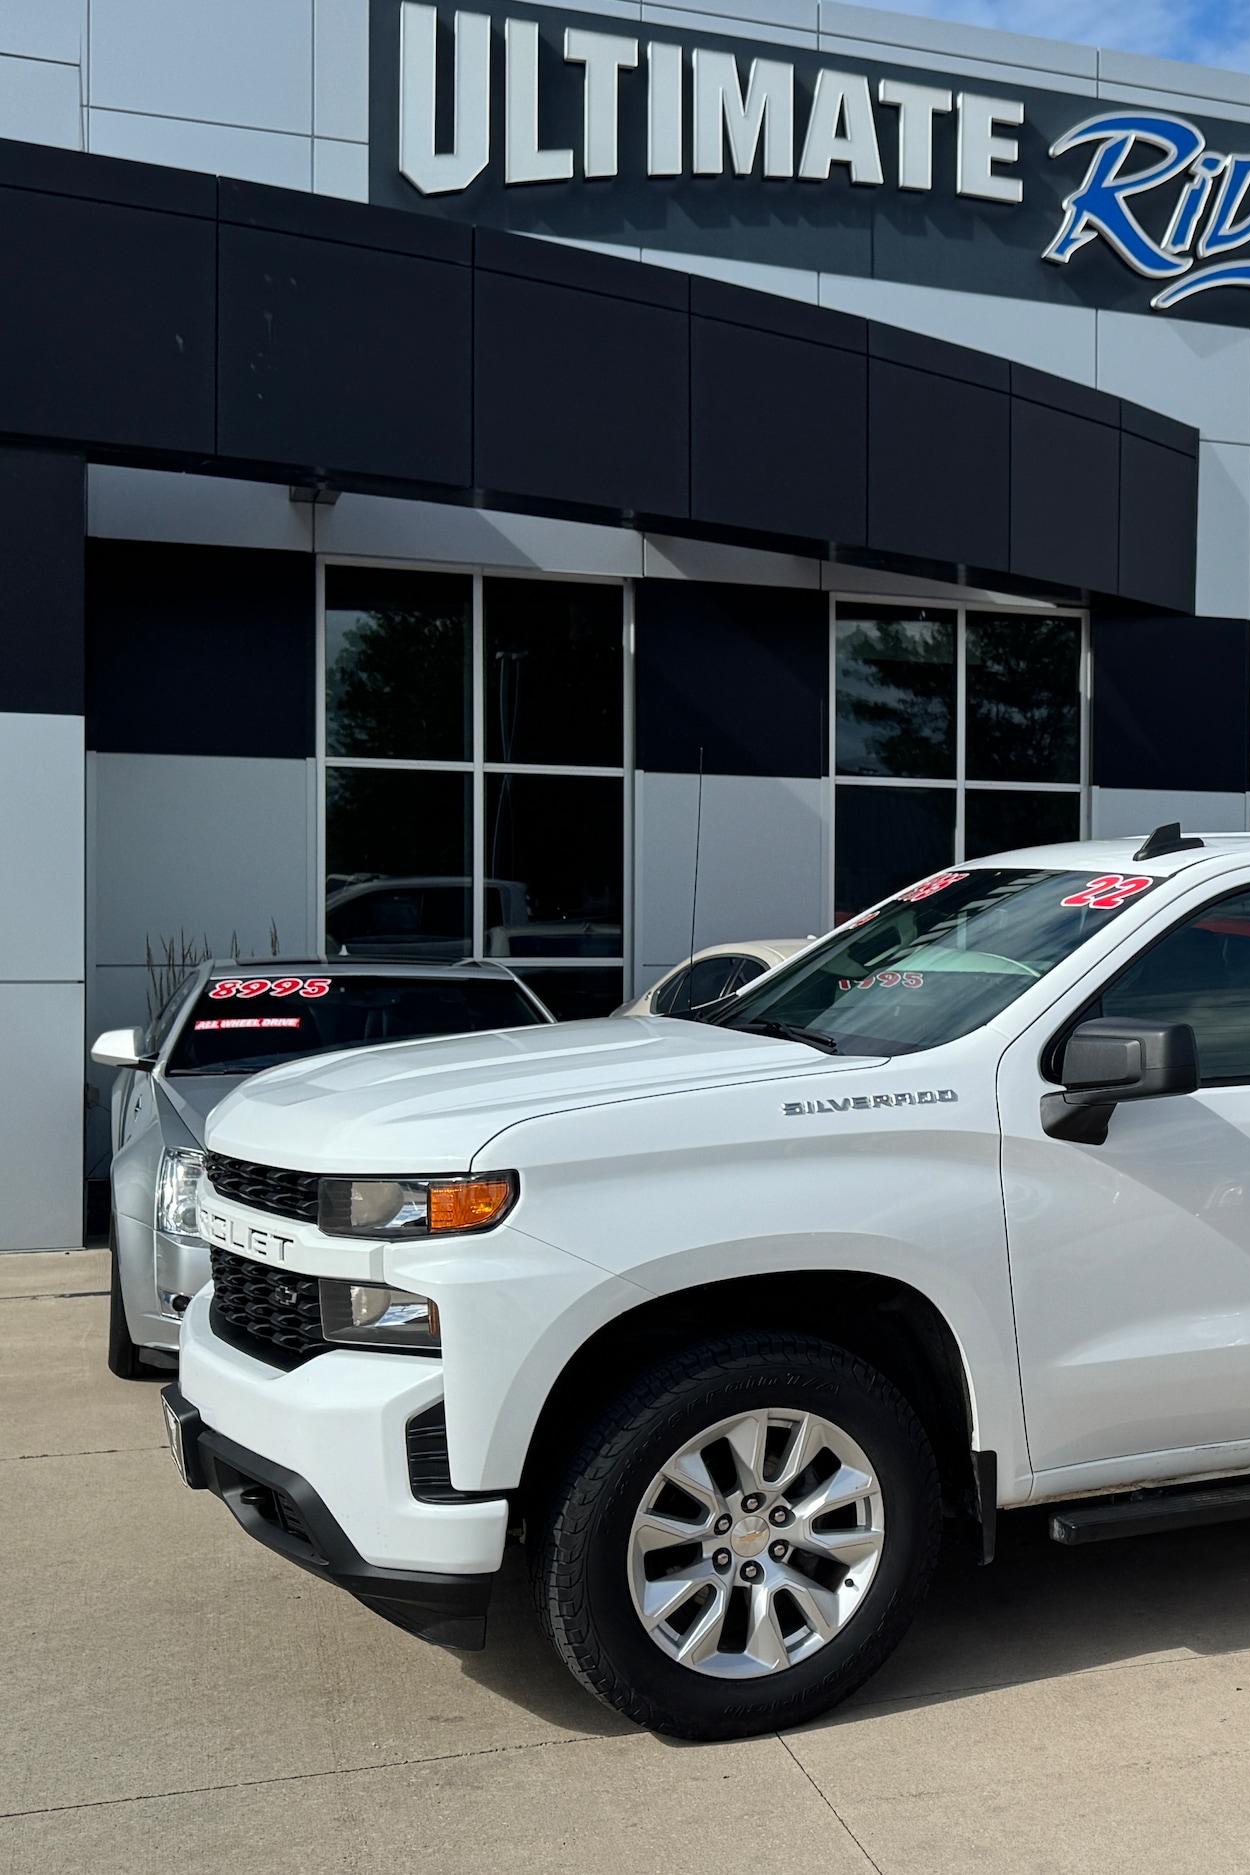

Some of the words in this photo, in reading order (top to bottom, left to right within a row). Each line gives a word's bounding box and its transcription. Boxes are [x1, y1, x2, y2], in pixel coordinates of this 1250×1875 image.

[399, 2, 1024, 203] ULTIMATE
[1060, 875, 1154, 910] 22
[209, 978, 332, 999] 8995
[195, 1020, 220, 1030] ALL
[220, 1019, 260, 1029] WHEEL
[261, 1018, 299, 1027] DRIVE
[780, 1089, 959, 1116] SILVERADO
